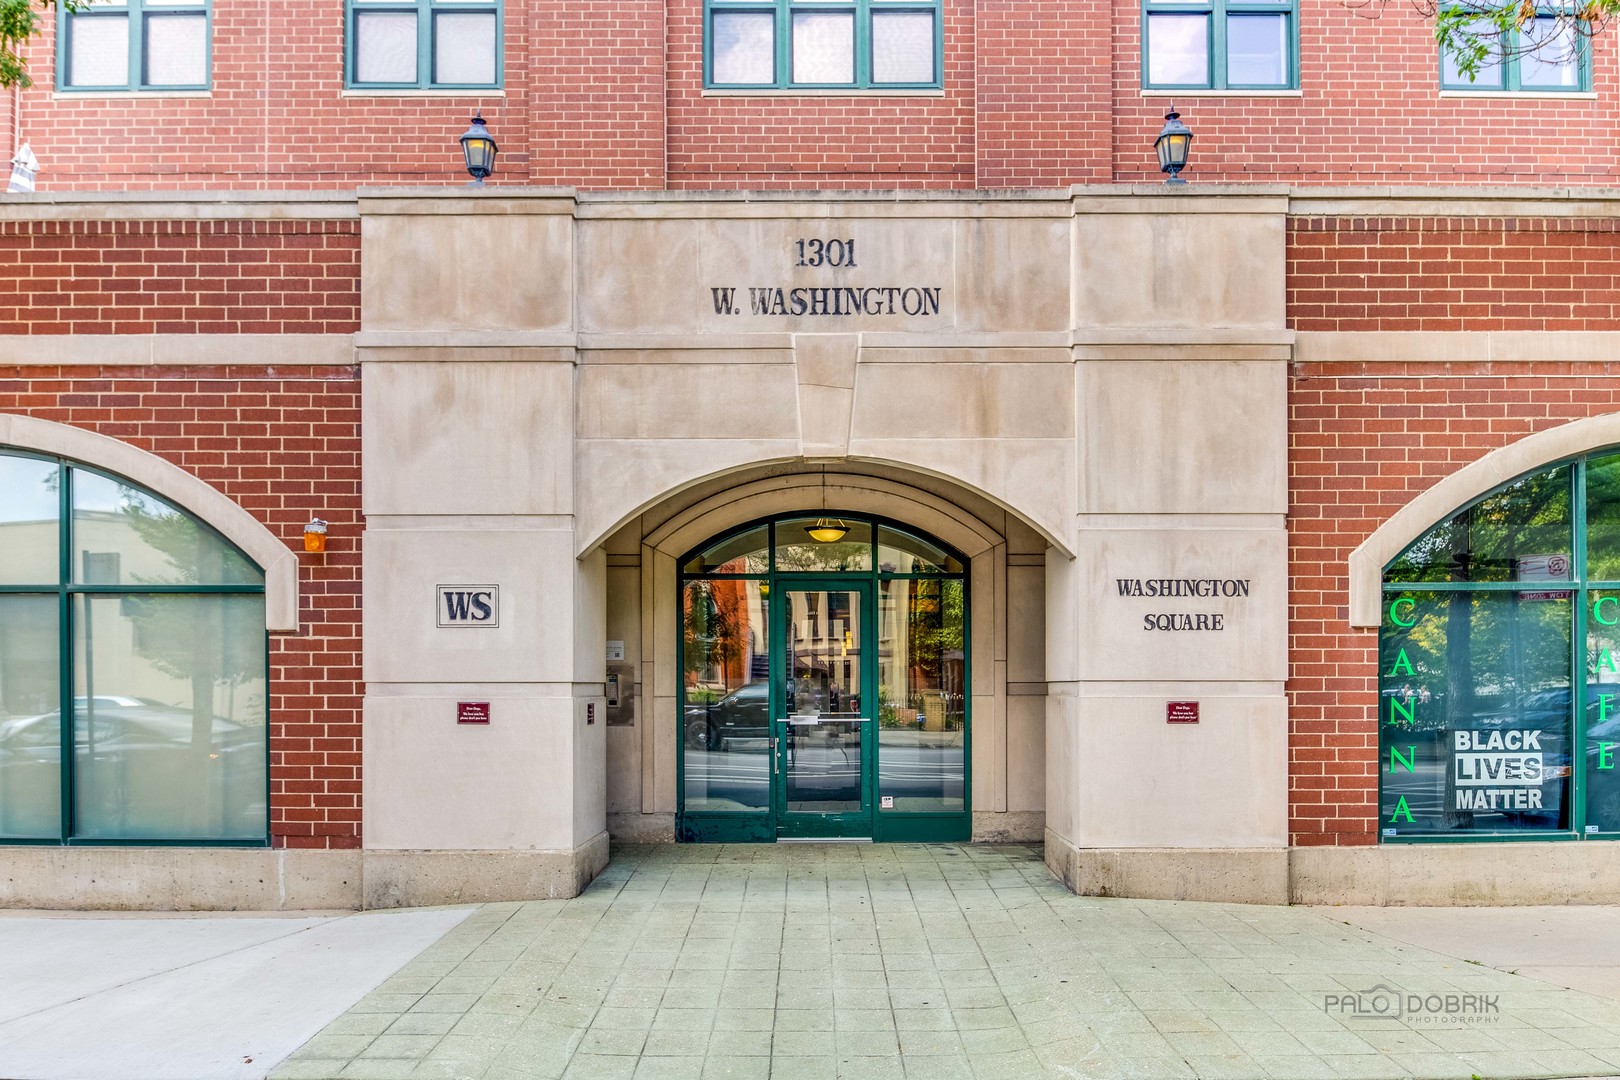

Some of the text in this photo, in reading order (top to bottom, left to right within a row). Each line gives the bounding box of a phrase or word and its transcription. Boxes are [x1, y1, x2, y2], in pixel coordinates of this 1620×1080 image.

[795, 238, 857, 267] 1301
[711, 287, 941, 315] W. WASHINGTON
[1116, 579, 1250, 597] WASHINGTON
[443, 591, 492, 621] WS
[1143, 614, 1224, 631] SQUARE
[1454, 730, 1542, 750] BLACK
[1457, 757, 1541, 780] LIVES
[1456, 789, 1543, 809] MATTER
